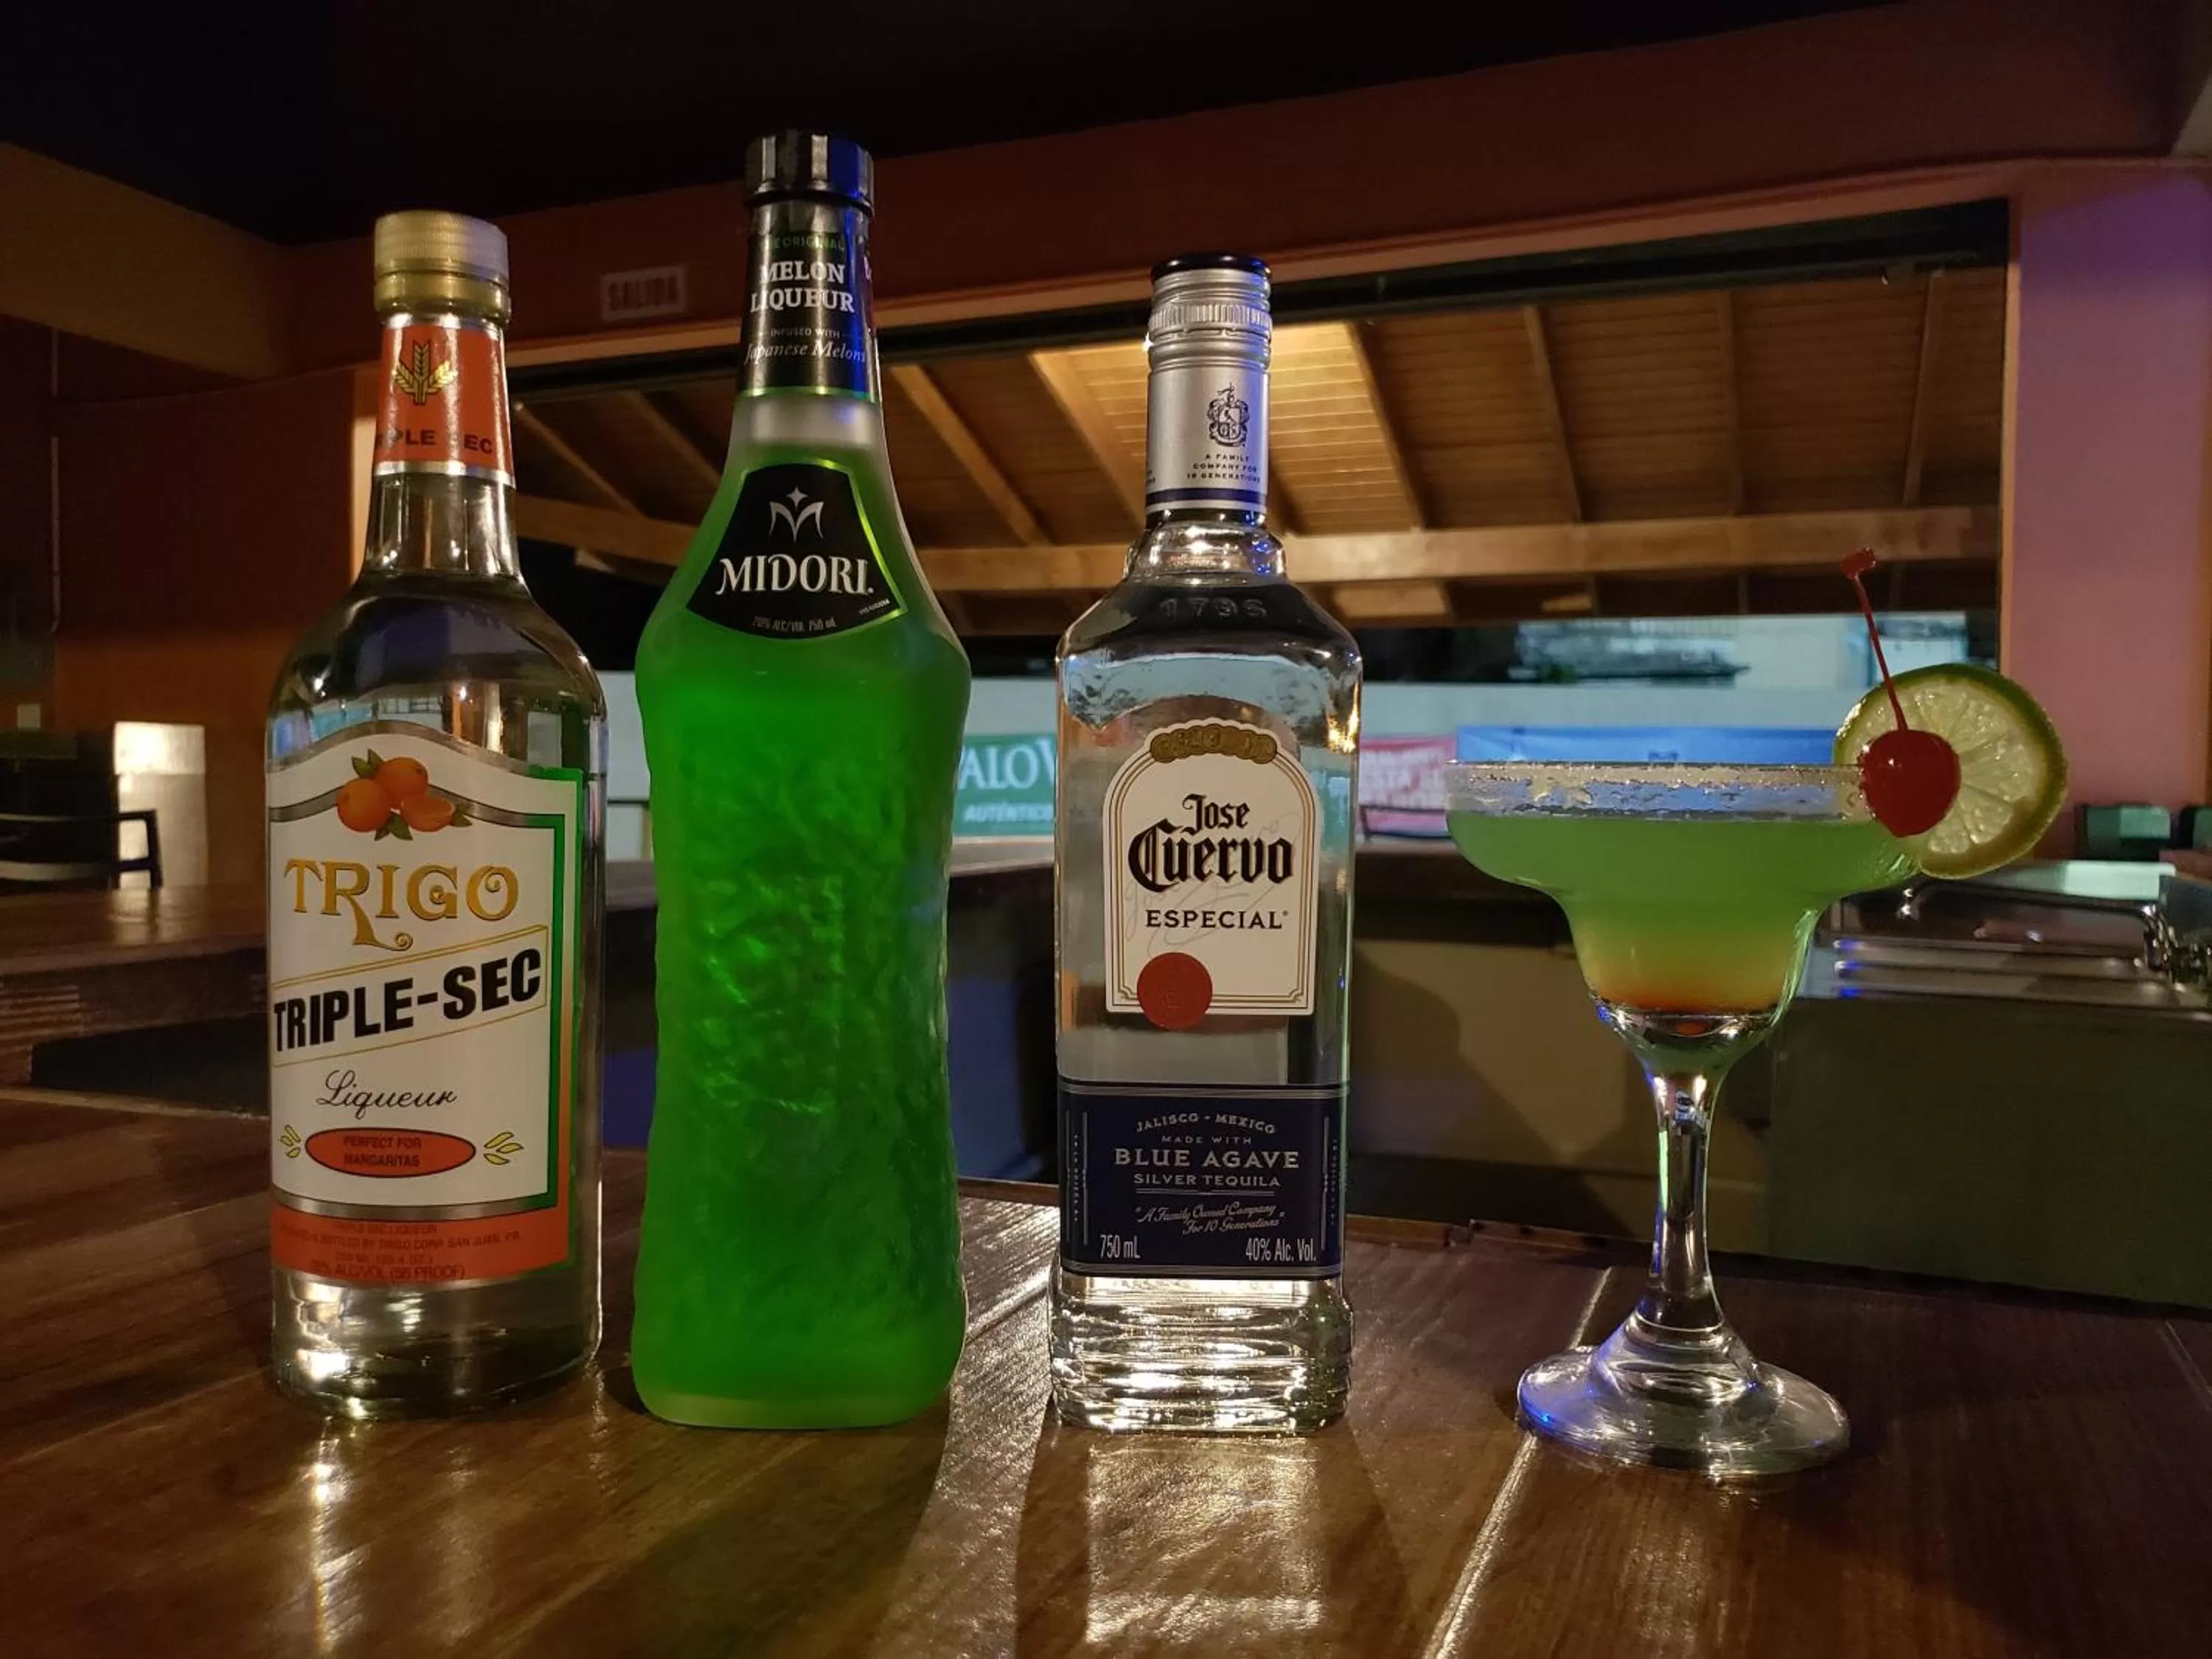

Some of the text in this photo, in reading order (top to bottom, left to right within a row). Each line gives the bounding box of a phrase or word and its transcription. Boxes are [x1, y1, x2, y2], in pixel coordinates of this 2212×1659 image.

[760, 260, 846, 284] MELON
[750, 287, 855, 313] LIQUEUR
[1192, 463, 1258, 473] COMPANY FOR
[1216, 453, 1250, 462] FAMILY
[714, 554, 871, 595] MIDORI
[1180, 793, 1251, 836] Jose
[1127, 818, 1294, 893] Cuervo
[283, 858, 519, 952] TRIGO
[1144, 908, 1283, 930] ESPECIAL
[273, 947, 541, 1052] TRIPLE-SEC
[316, 1068, 459, 1120] Liqueur
[1136, 1113, 1276, 1134] JALISCO MEXICO
[1161, 1135, 1252, 1145] MADE WITH
[1113, 1147, 1300, 1169] BLUE AGAVE
[1133, 1173, 1281, 1187] SILVER TEQUILA
[1153, 1206, 1191, 1225] Family
[1192, 1203, 1229, 1219] Owned
[1227, 1200, 1277, 1219] Company
[1181, 1220, 1206, 1236] For
[1099, 1234, 1141, 1259] 750 mL
[1245, 1238, 1316, 1262] 40% Alc. Vol.
